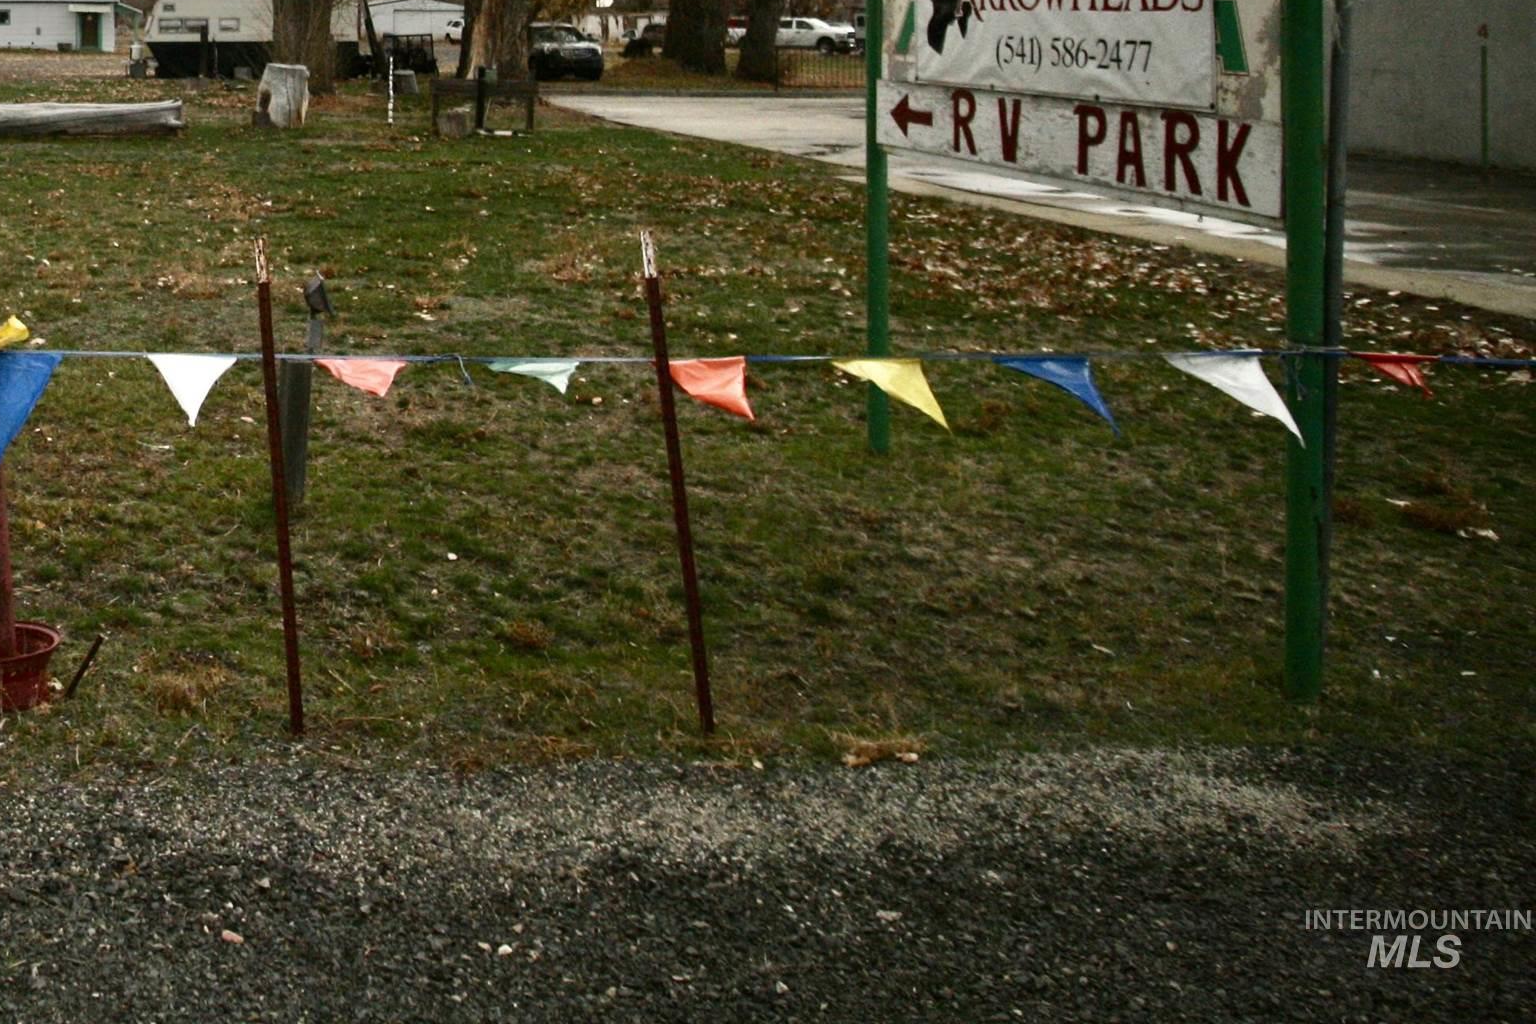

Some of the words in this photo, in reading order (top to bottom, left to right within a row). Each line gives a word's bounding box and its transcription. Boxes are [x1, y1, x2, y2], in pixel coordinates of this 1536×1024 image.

[995, 34, 1042, 74] (541)
[1050, 37, 1153, 73] 586-2477
[1072, 103, 1252, 208] PARK
